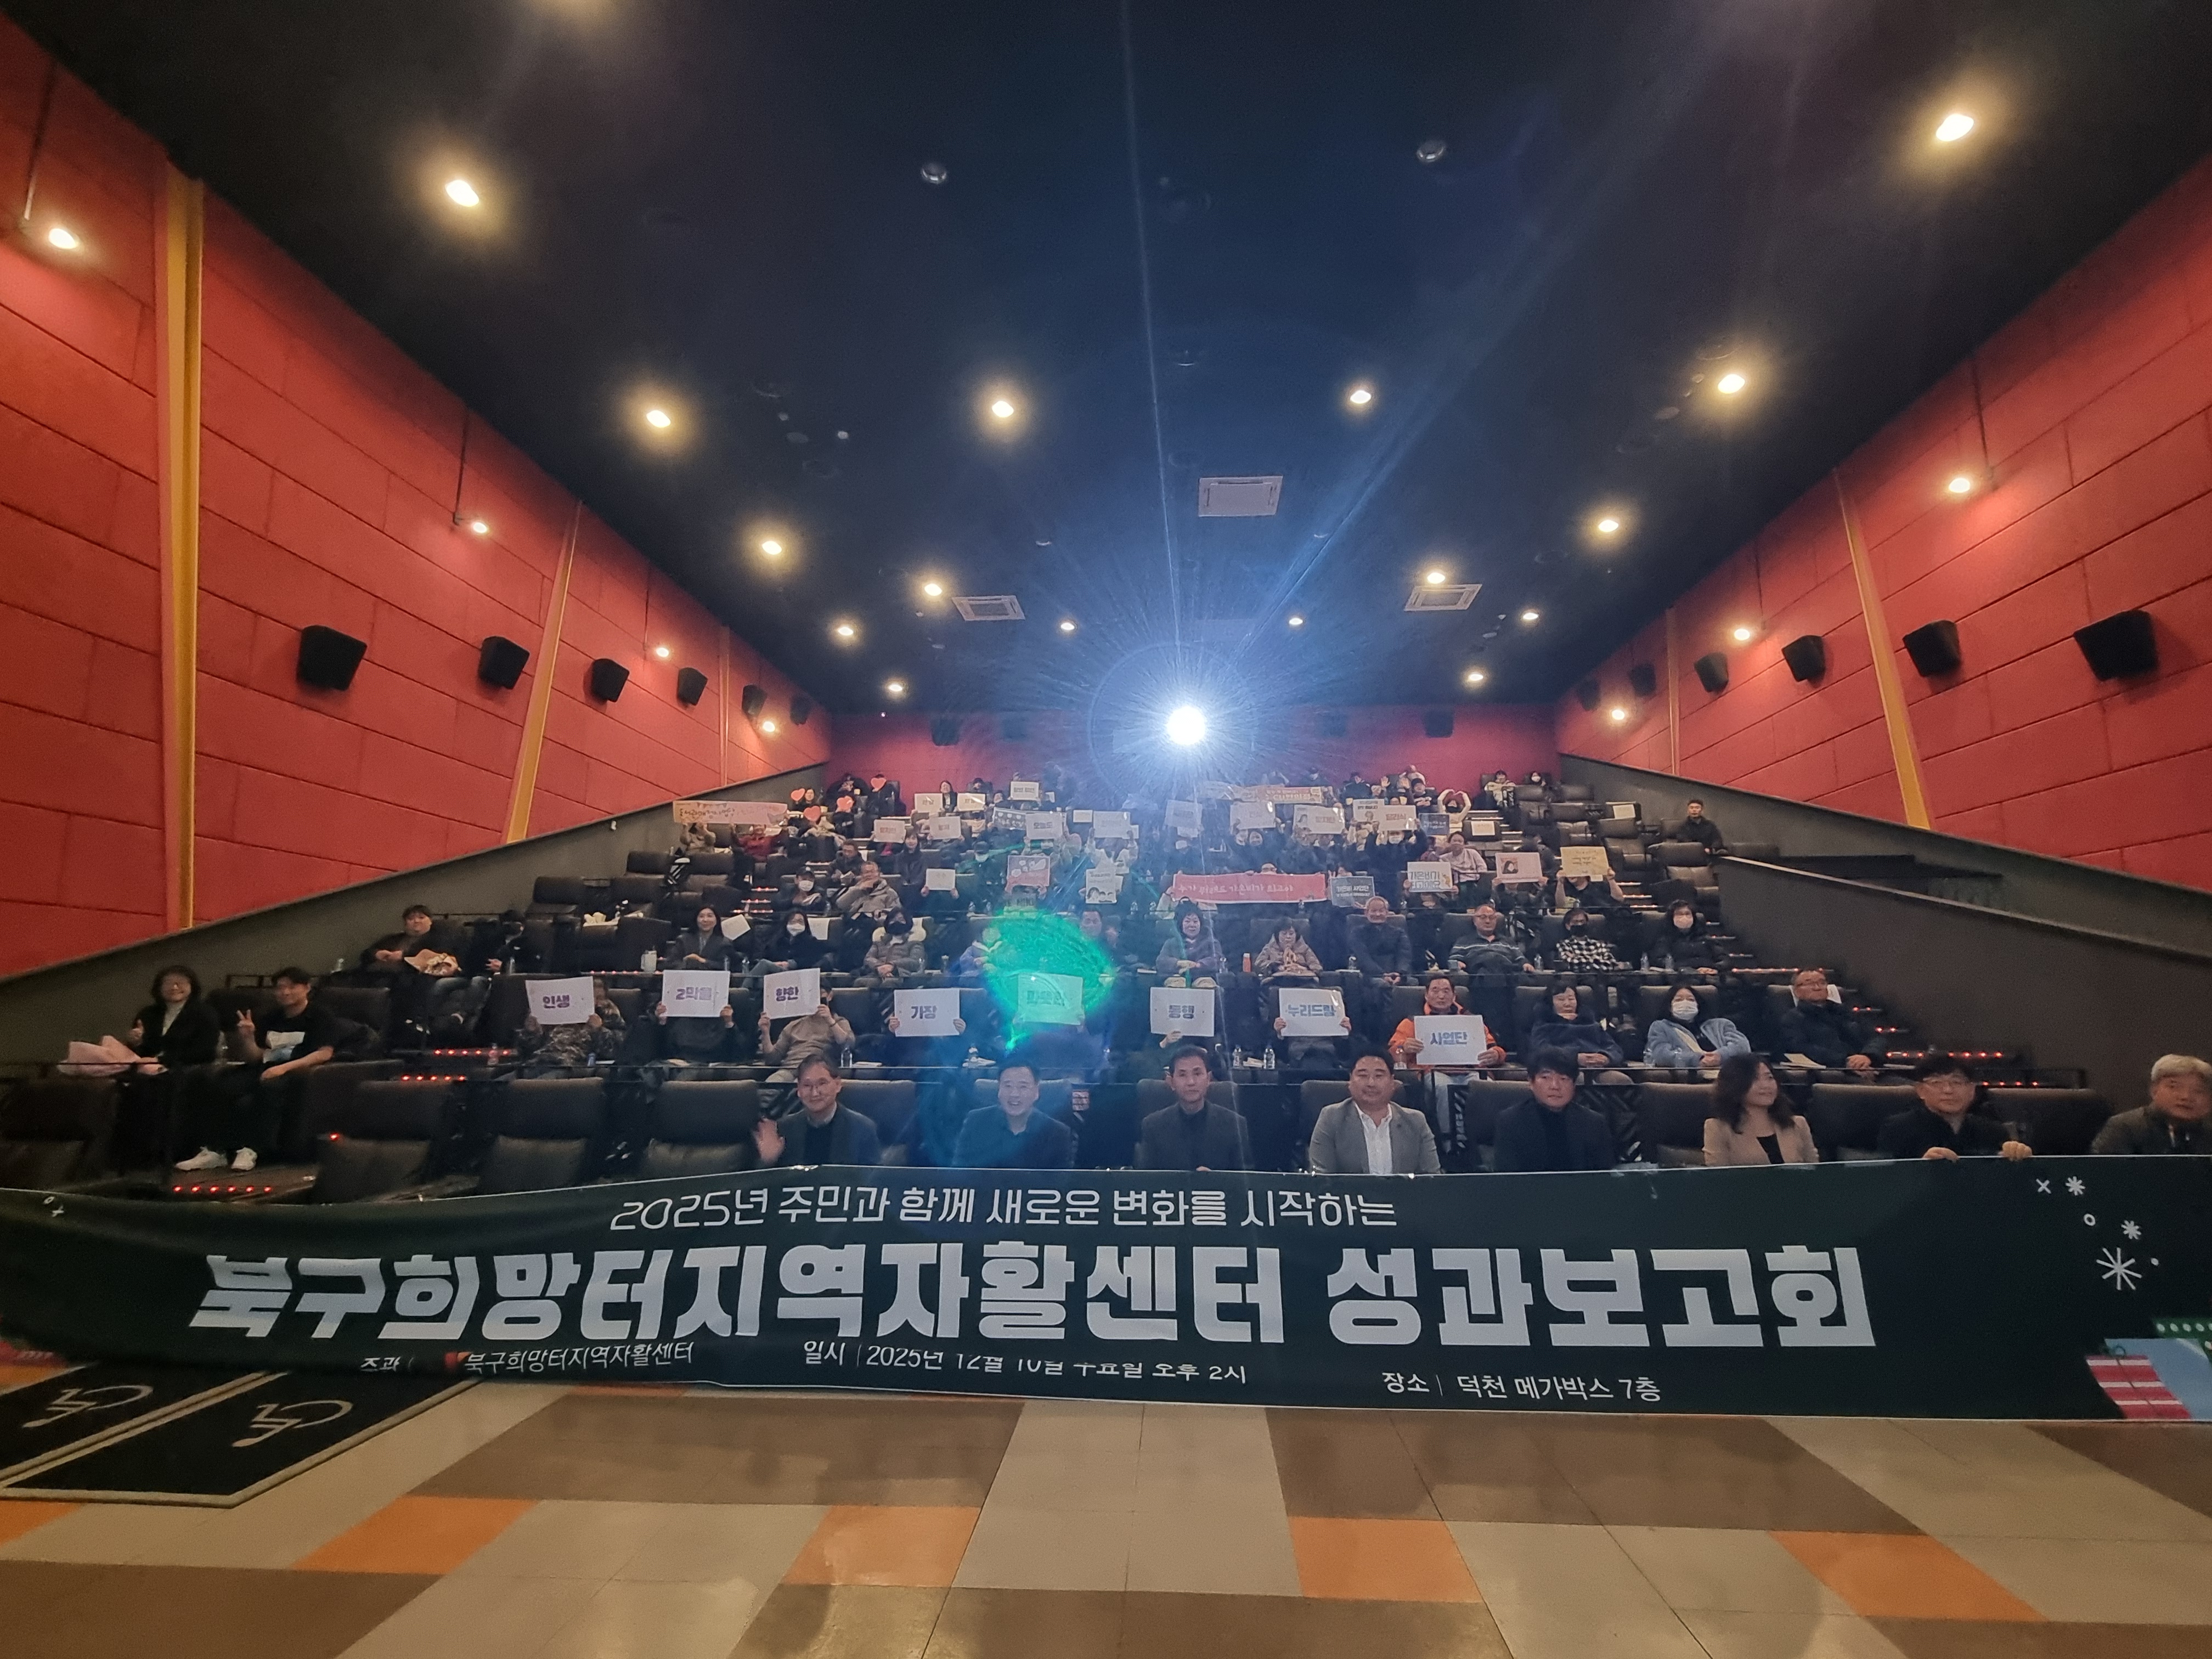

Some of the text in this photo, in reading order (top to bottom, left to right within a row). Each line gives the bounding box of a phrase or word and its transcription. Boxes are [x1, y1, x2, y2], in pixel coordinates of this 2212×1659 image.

[542, 995, 570, 1009] 인생
[776, 986, 799, 1002] 향한
[911, 1006, 936, 1019] 가장
[1169, 1005, 1195, 1020] 동행
[1430, 1031, 1468, 1046] 사업단
[610, 1186, 1397, 1230] 2025년 주민과 함께 새로운 변화를 시작하는
[189, 1240, 1876, 1347] 북구희망터지역자활센터 성과보고회
[464, 1341, 694, 1373] 북구희망터지역자활센터
[804, 1341, 845, 1365] 일시
[866, 1345, 944, 1370] 2025년
[1209, 1365, 1245, 1384] 2시
[1382, 1372, 1661, 1402] 장소 덕천 메가박스 7층
